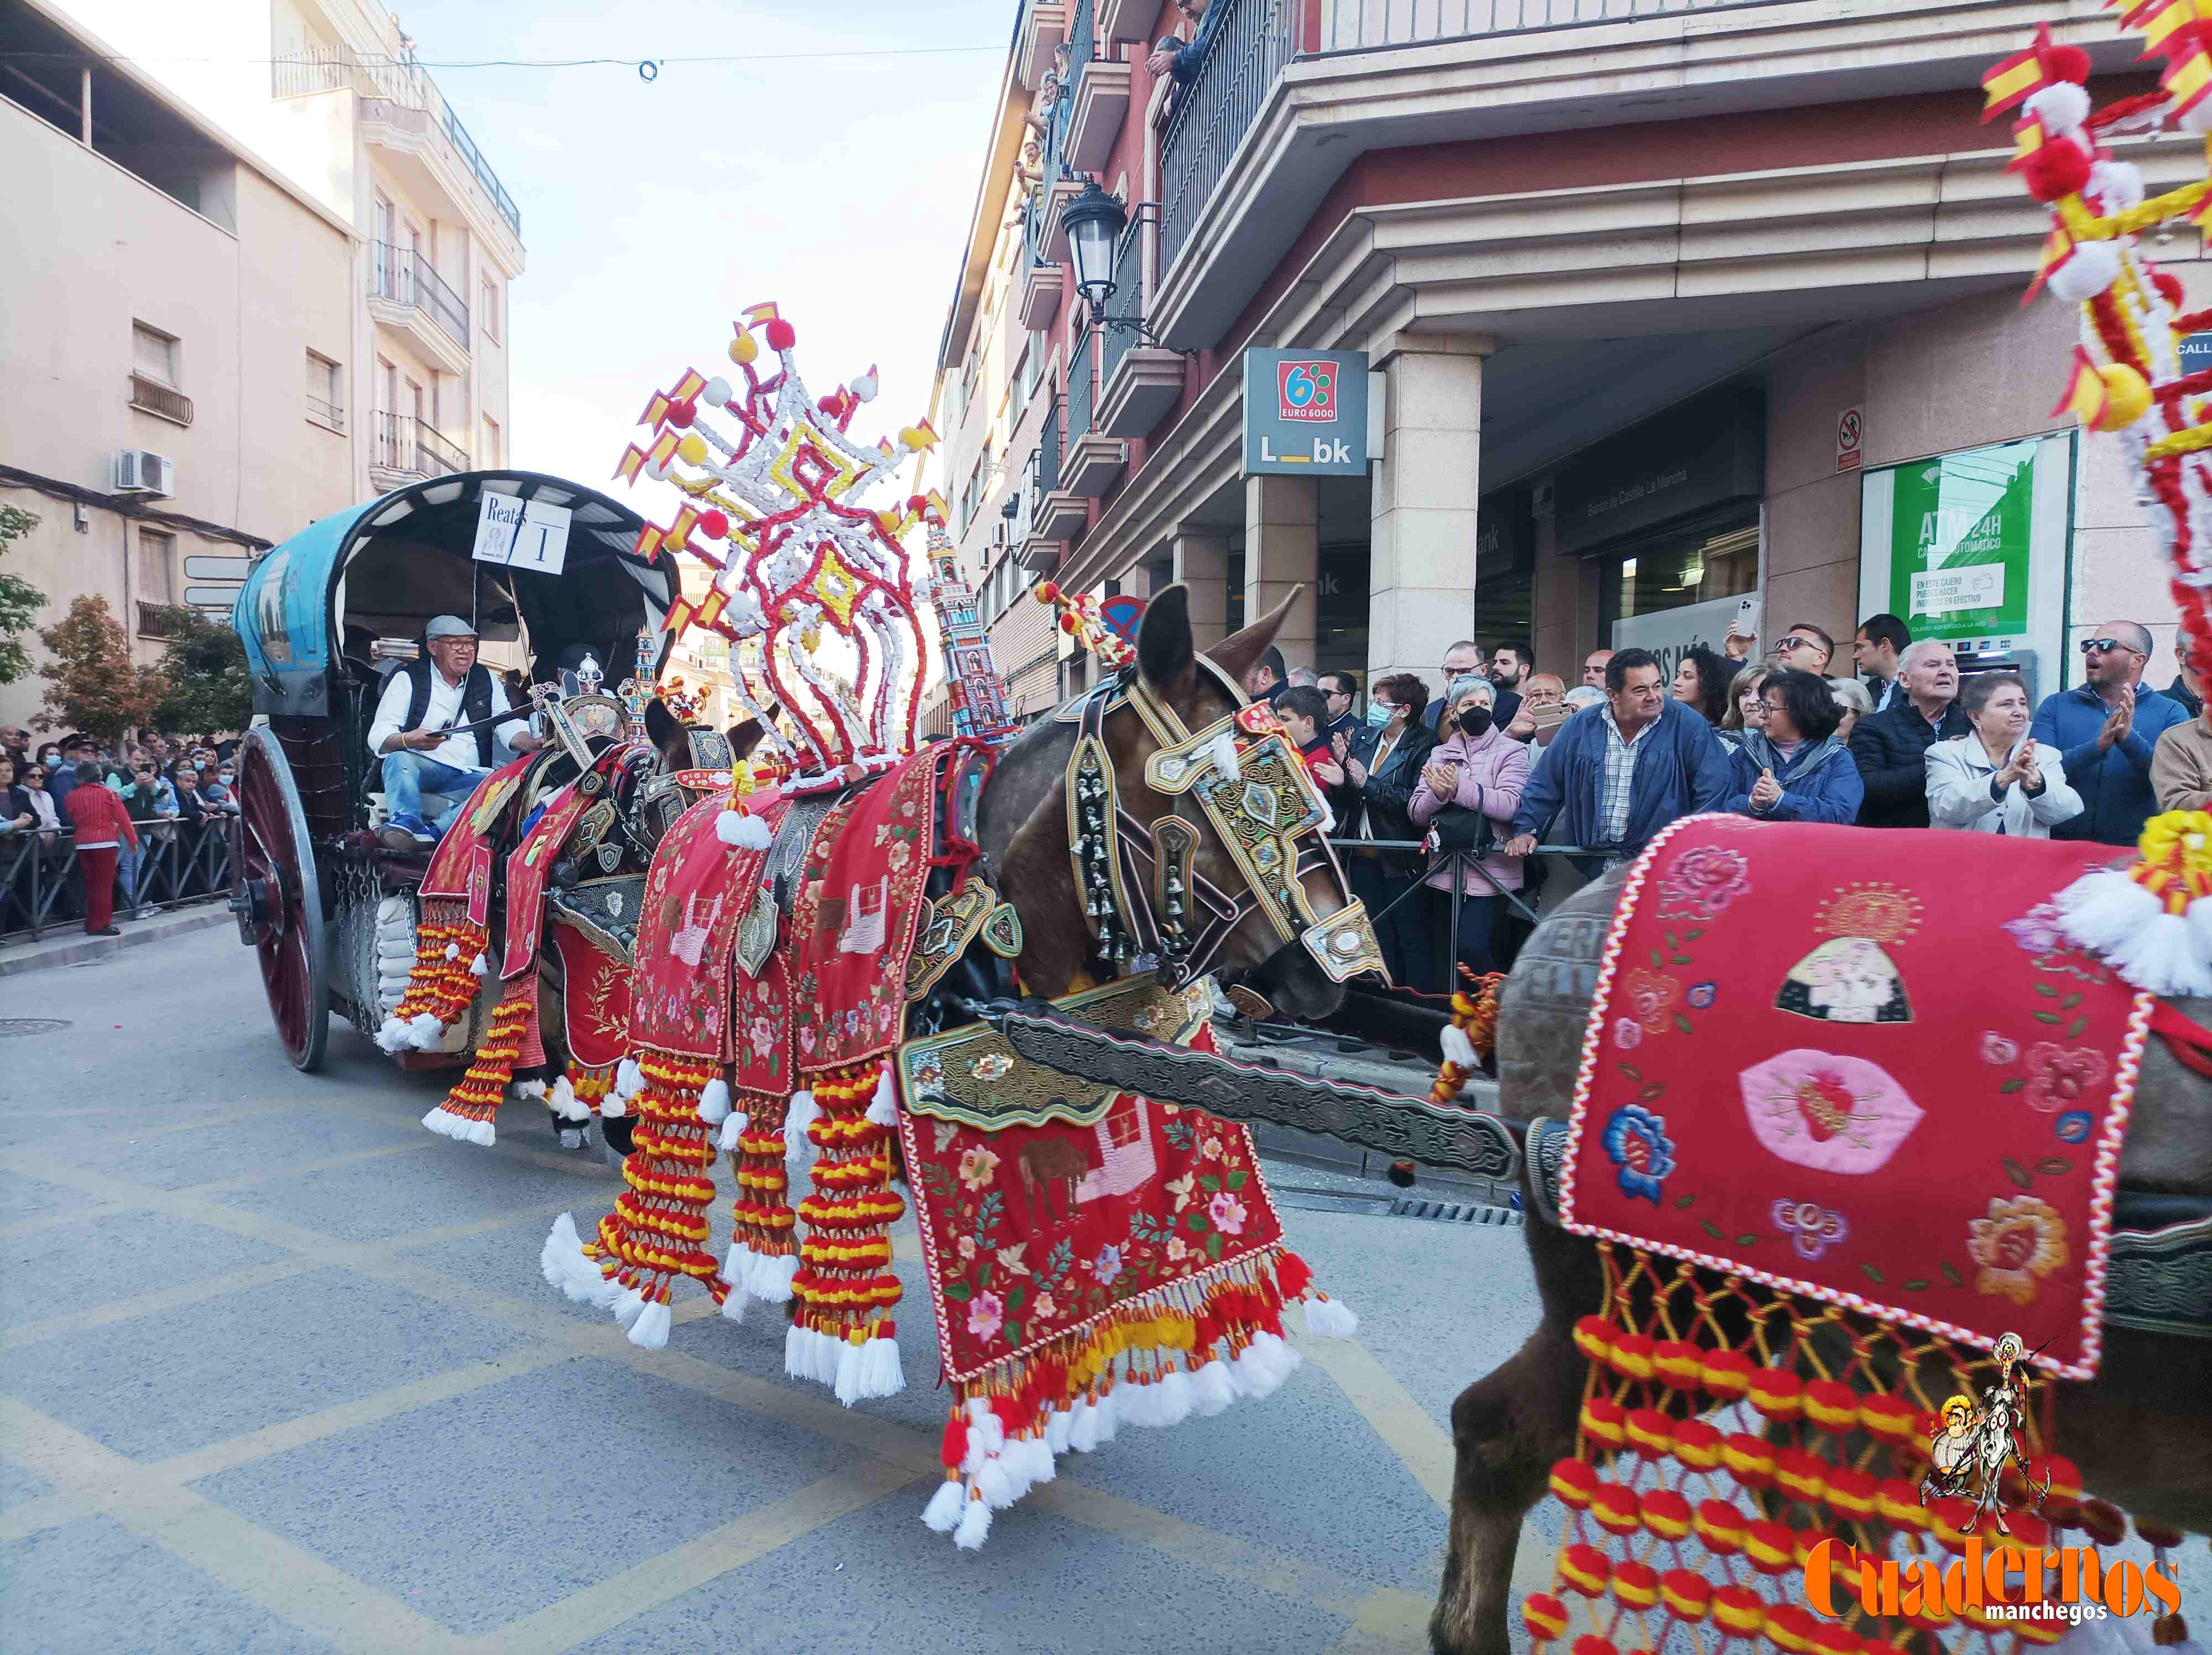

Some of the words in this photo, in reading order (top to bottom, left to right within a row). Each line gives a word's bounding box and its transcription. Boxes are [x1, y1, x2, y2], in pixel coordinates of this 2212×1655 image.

[1282, 408, 1306, 417] EURO
[1308, 408, 1334, 418] 6000
[1588, 501, 1608, 517] Banco
[1610, 496, 1618, 509] de
[1619, 483, 1645, 504] Castilla
[1647, 481, 1656, 493] La
[1656, 469, 1687, 489] Mancha
[487, 497, 528, 527] Reatas
[1971, 514, 2001, 538] 24H
[535, 528, 547, 562] 1
[1954, 537, 2001, 554] UTOMÁTICO
[1917, 580, 1924, 589] EN
[1926, 579, 1939, 588] ESTE
[1940, 576, 1962, 586] CAJERO
[1939, 587, 1958, 596] HACER
[1944, 596, 1952, 605] EN
[1954, 594, 1981, 604] EFECTIVO
